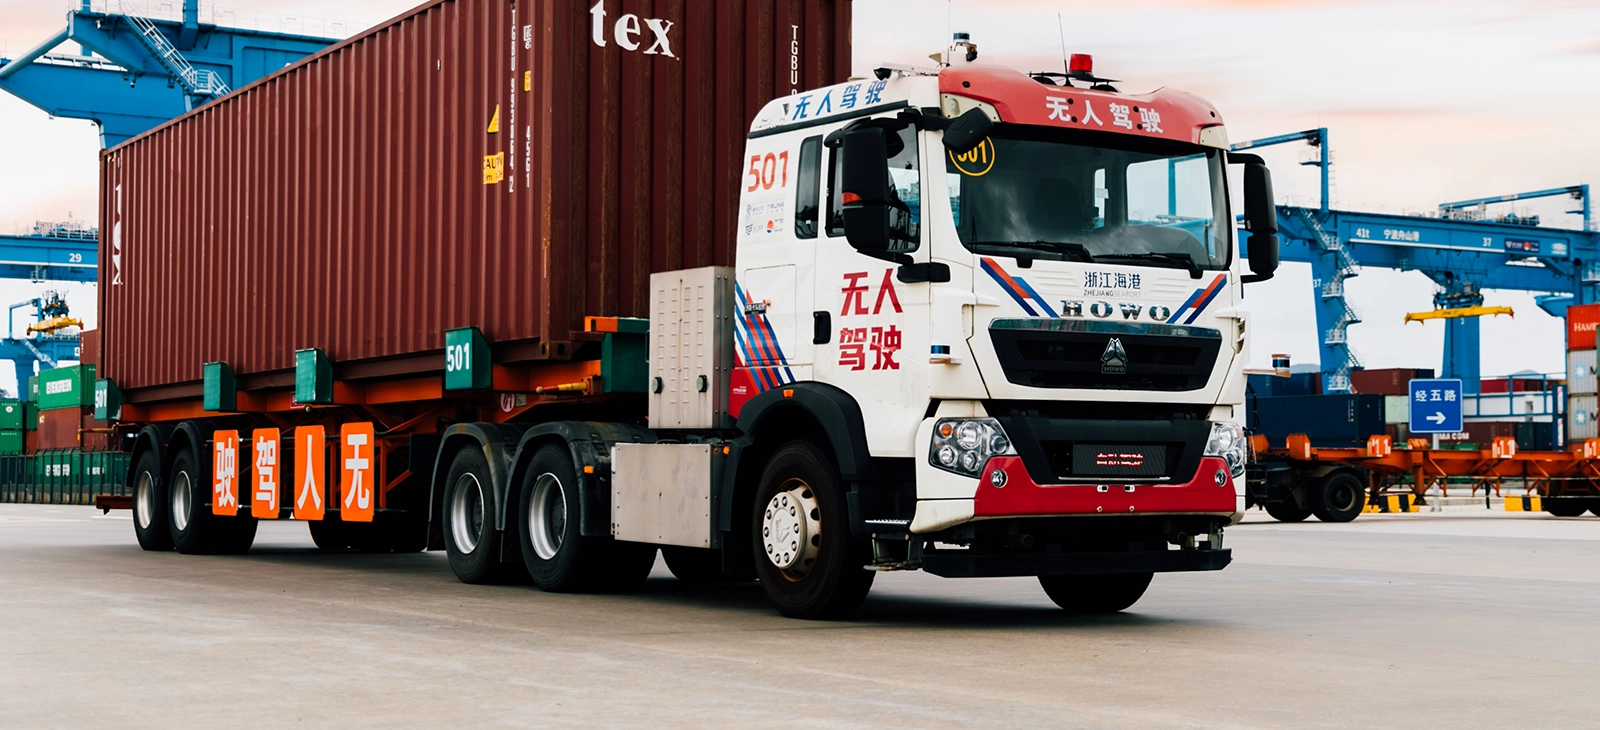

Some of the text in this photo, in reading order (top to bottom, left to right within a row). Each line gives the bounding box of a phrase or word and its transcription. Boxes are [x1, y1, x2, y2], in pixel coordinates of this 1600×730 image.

[590, 0, 675, 58] tex
[791, 81, 888, 121] 无人驾驶
[1045, 95, 1163, 134] 无人驾驶
[747, 150, 788, 192] 501
[69, 252, 82, 262] 29
[1482, 237, 1492, 247] 37
[840, 268, 903, 316] 无人
[1084, 271, 1141, 289] 浙江海港
[1060, 300, 1171, 321] HOWO
[447, 342, 470, 372] 501
[839, 325, 902, 371] 驾驶
[95, 389, 107, 408] 501
[1415, 389, 1456, 402] 经五路
